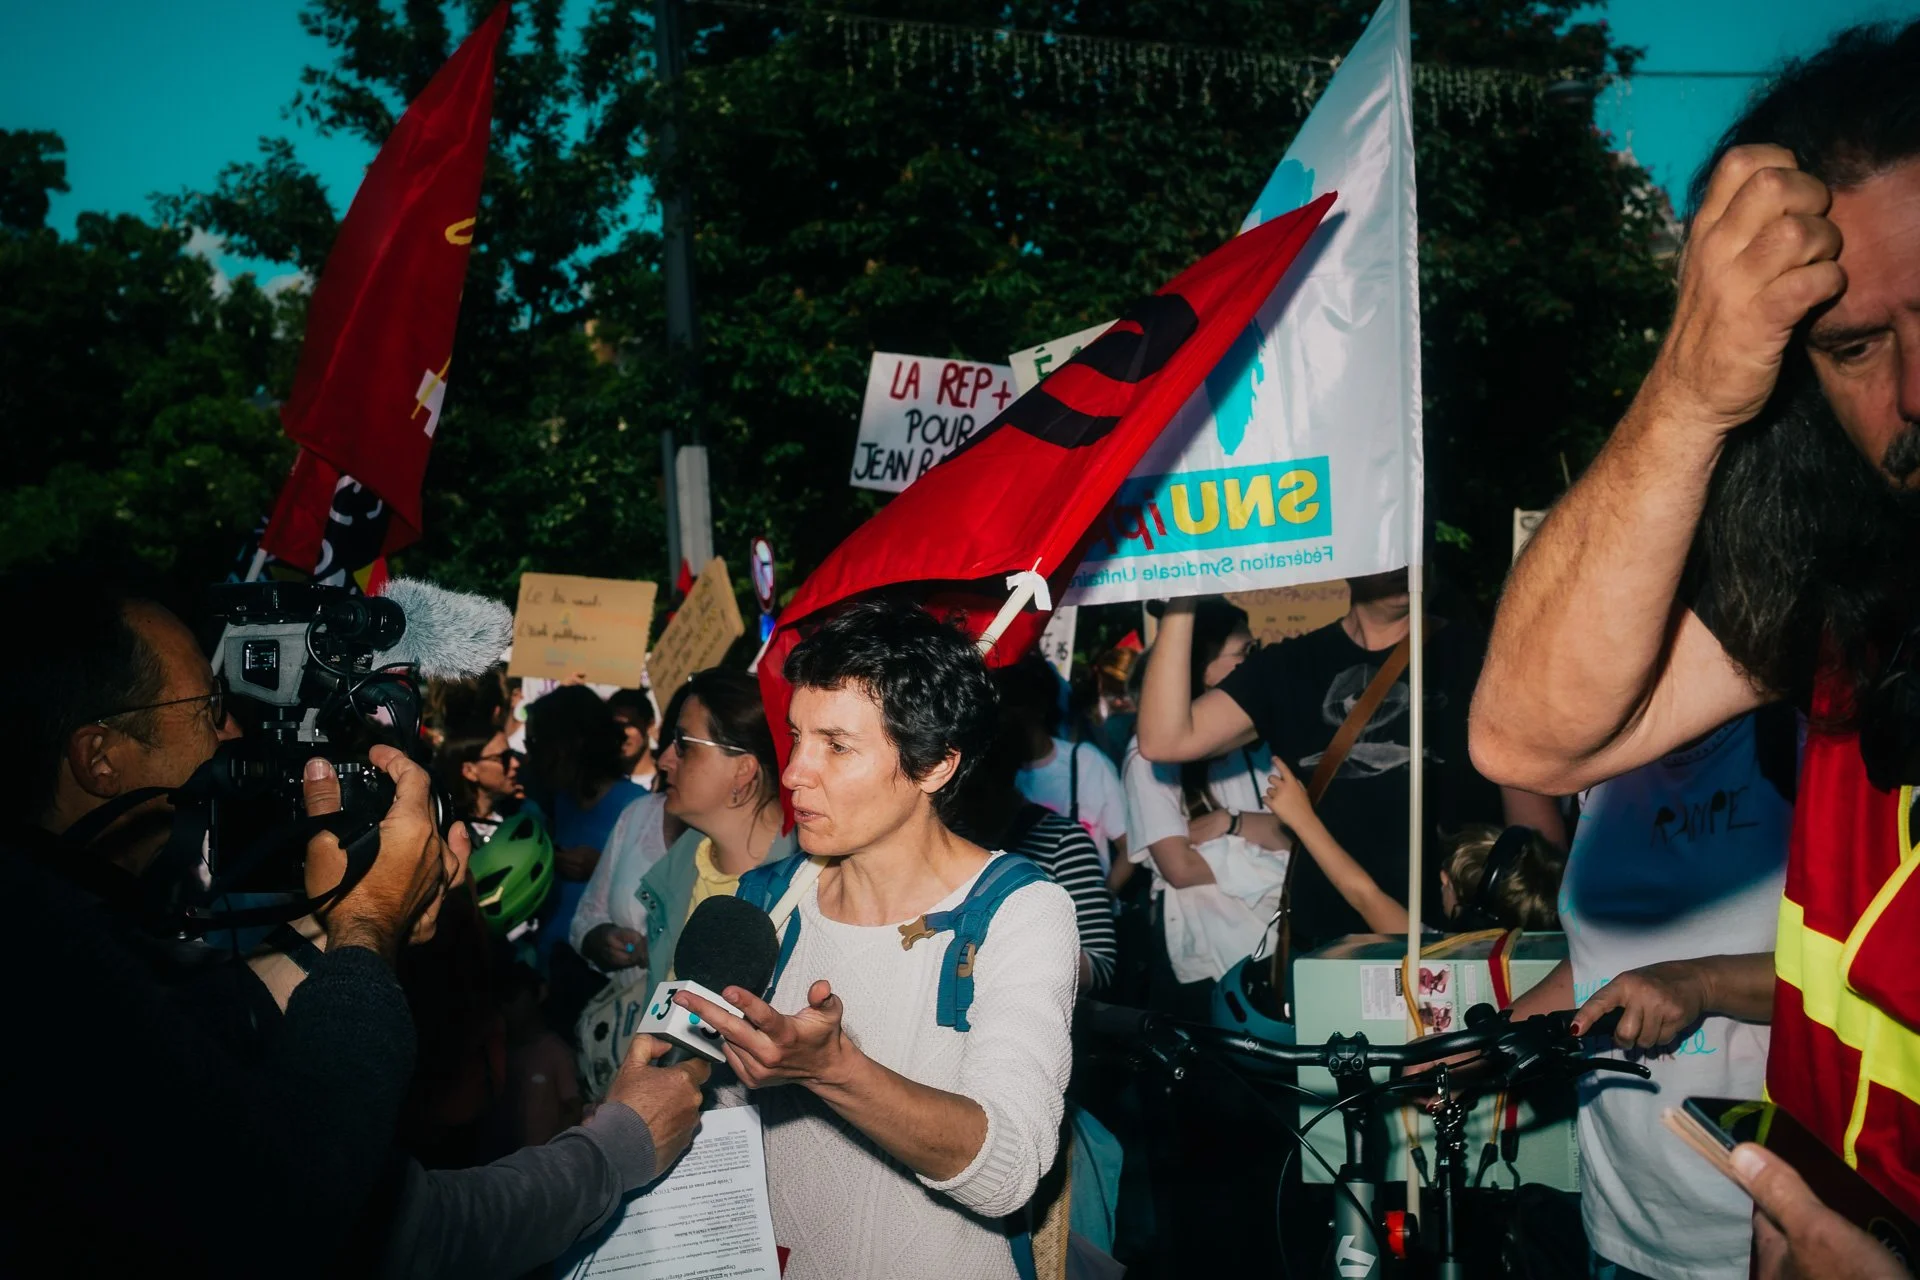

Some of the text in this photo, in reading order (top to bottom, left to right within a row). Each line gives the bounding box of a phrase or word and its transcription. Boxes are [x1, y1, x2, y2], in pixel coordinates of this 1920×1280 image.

[890, 361, 1012, 410] LA REP+
[905, 408, 975, 447] POUR
[854, 442, 914, 482] JEAN
